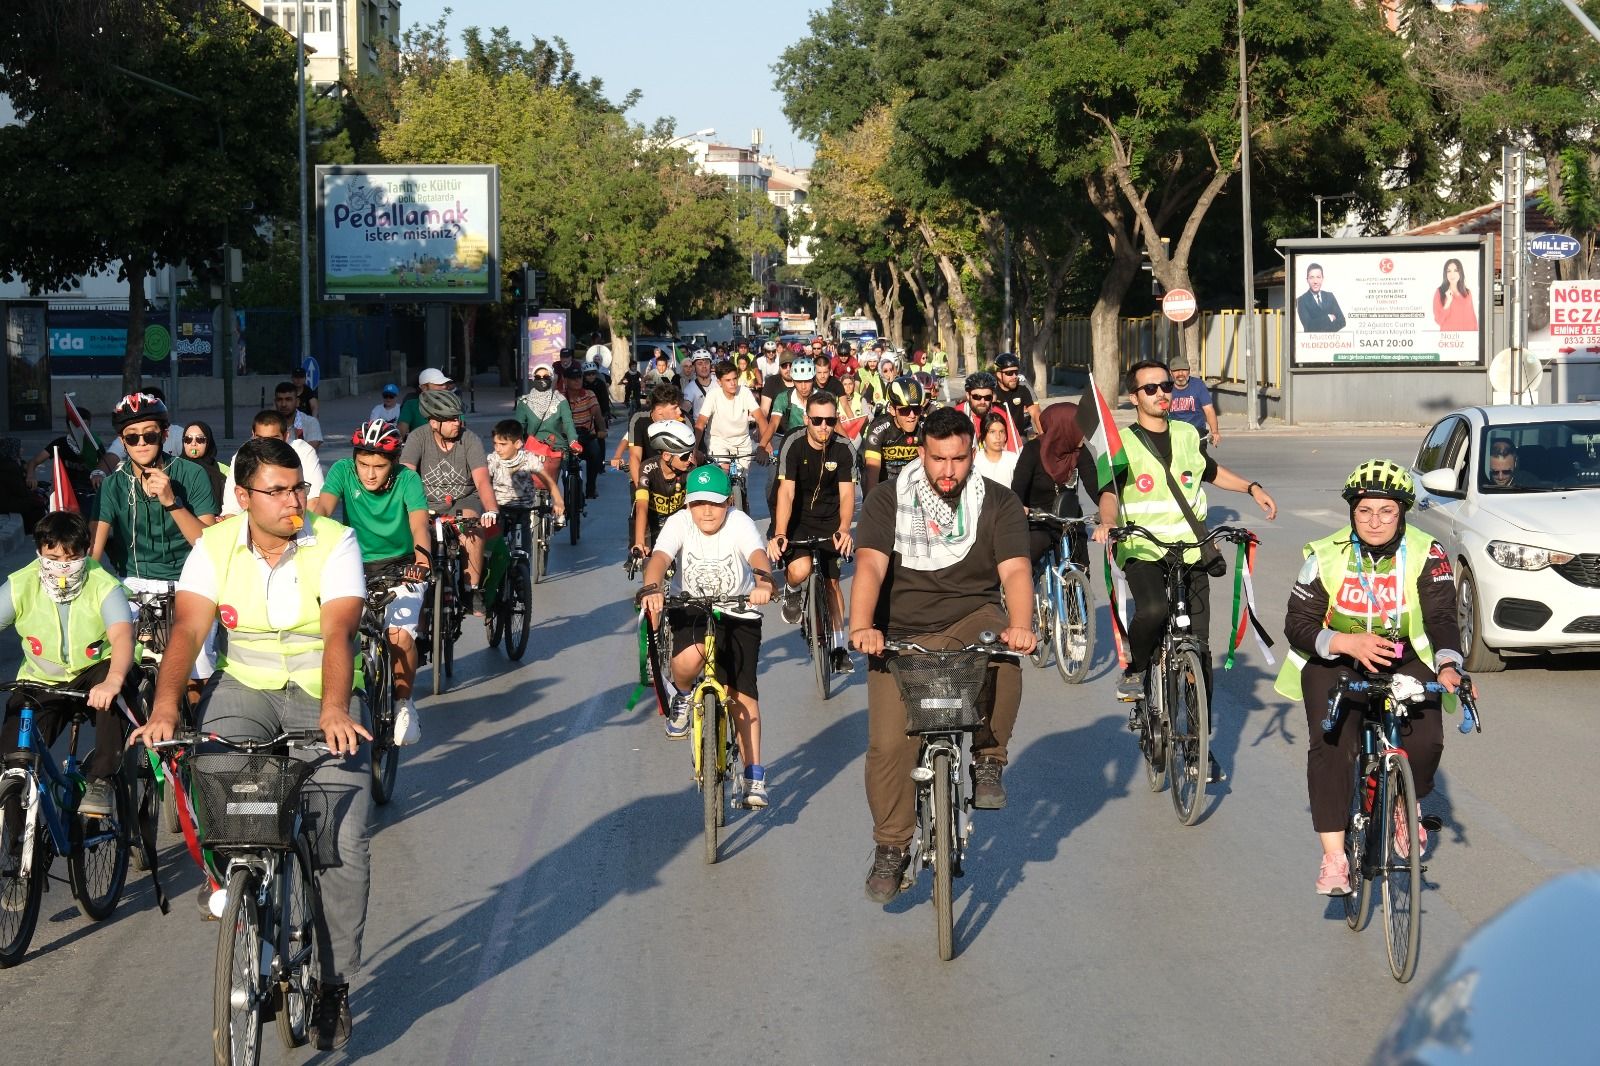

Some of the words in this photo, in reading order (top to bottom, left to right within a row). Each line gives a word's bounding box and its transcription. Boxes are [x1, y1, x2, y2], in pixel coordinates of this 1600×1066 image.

[387, 180, 412, 193] Tarih
[415, 182, 427, 192] ve
[430, 179, 462, 191] Kültür
[398, 194, 415, 203] Dolu
[417, 193, 455, 202] Rotalarda
[334, 200, 468, 229] Pedallamak
[366, 228, 399, 242] ister
[403, 223, 461, 241] misiniz?
[1301, 340, 1352, 349] YILDIZDOĞAN
[1359, 339, 1385, 348] SAAT
[1386, 339, 1414, 348] 20:00
[1564, 336, 1584, 345] 0332
